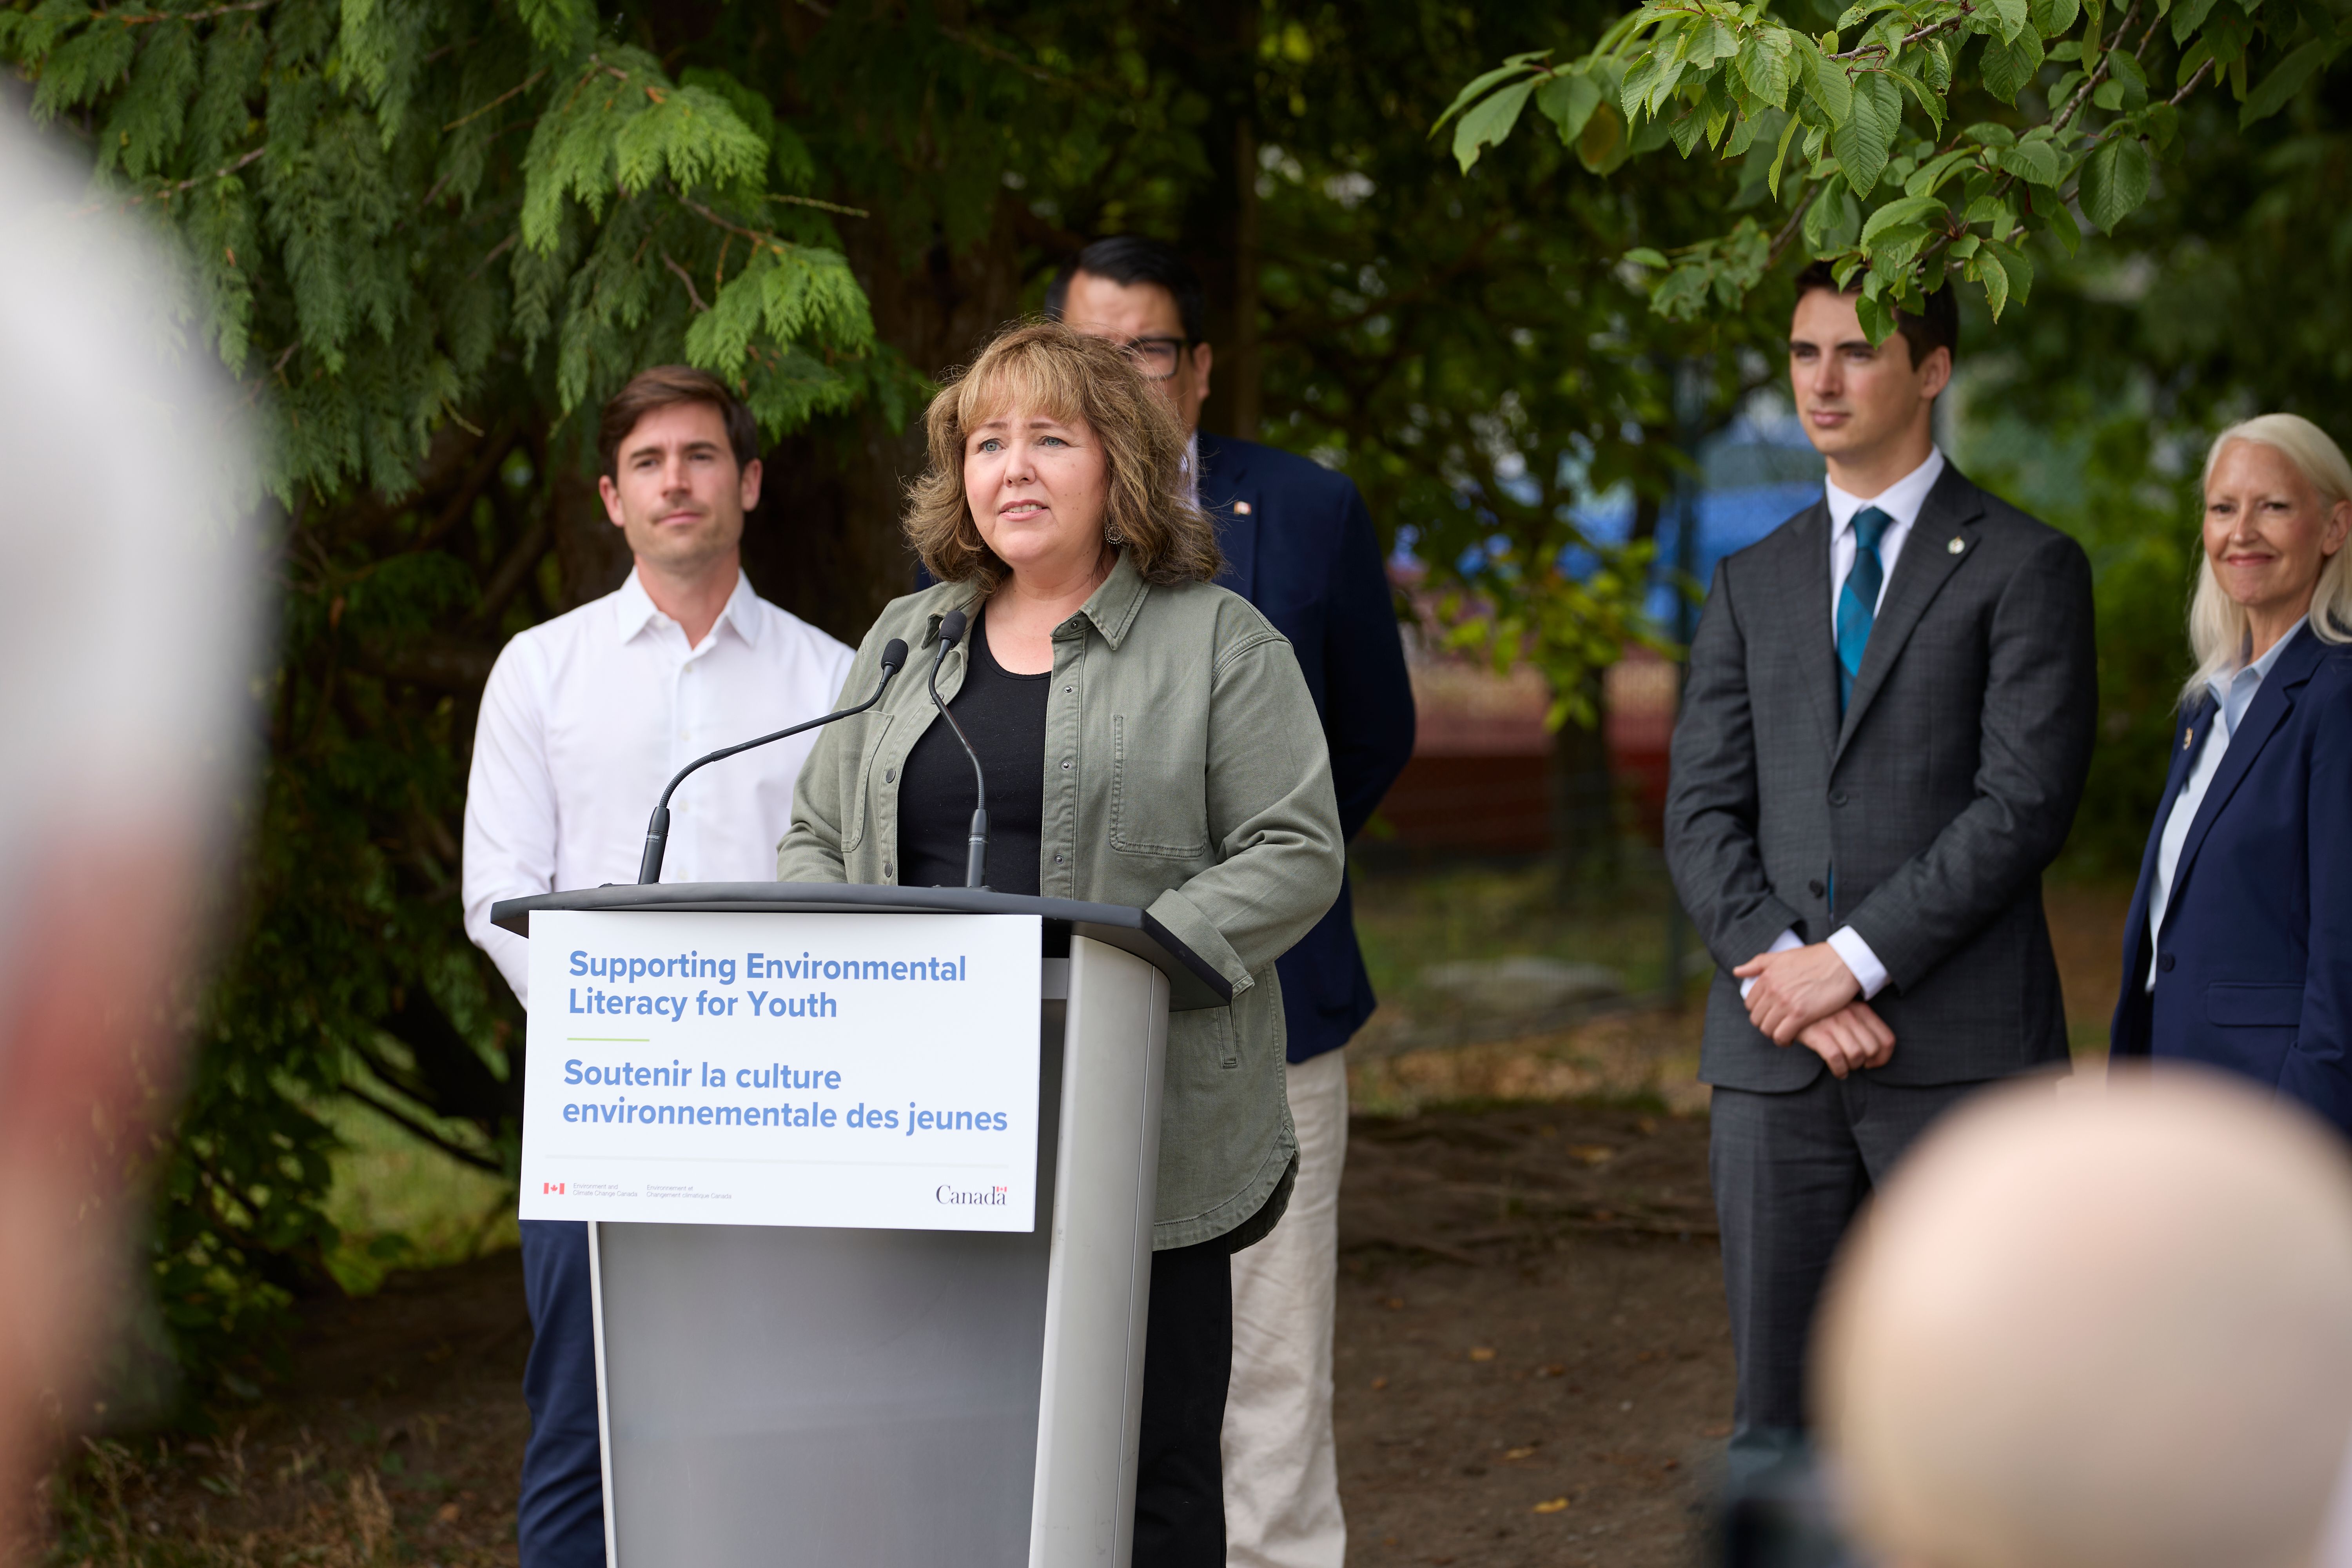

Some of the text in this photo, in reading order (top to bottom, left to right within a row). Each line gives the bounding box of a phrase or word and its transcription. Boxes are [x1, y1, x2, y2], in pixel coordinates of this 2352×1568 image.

[569, 950, 965, 985] Supporting Environmental
[570, 987, 837, 1022] Literacy for Youth
[564, 1059, 841, 1089] Soutenir la culture
[563, 1096, 1007, 1136] environnementale des jeunes
[936, 1185, 1007, 1206] Canada
